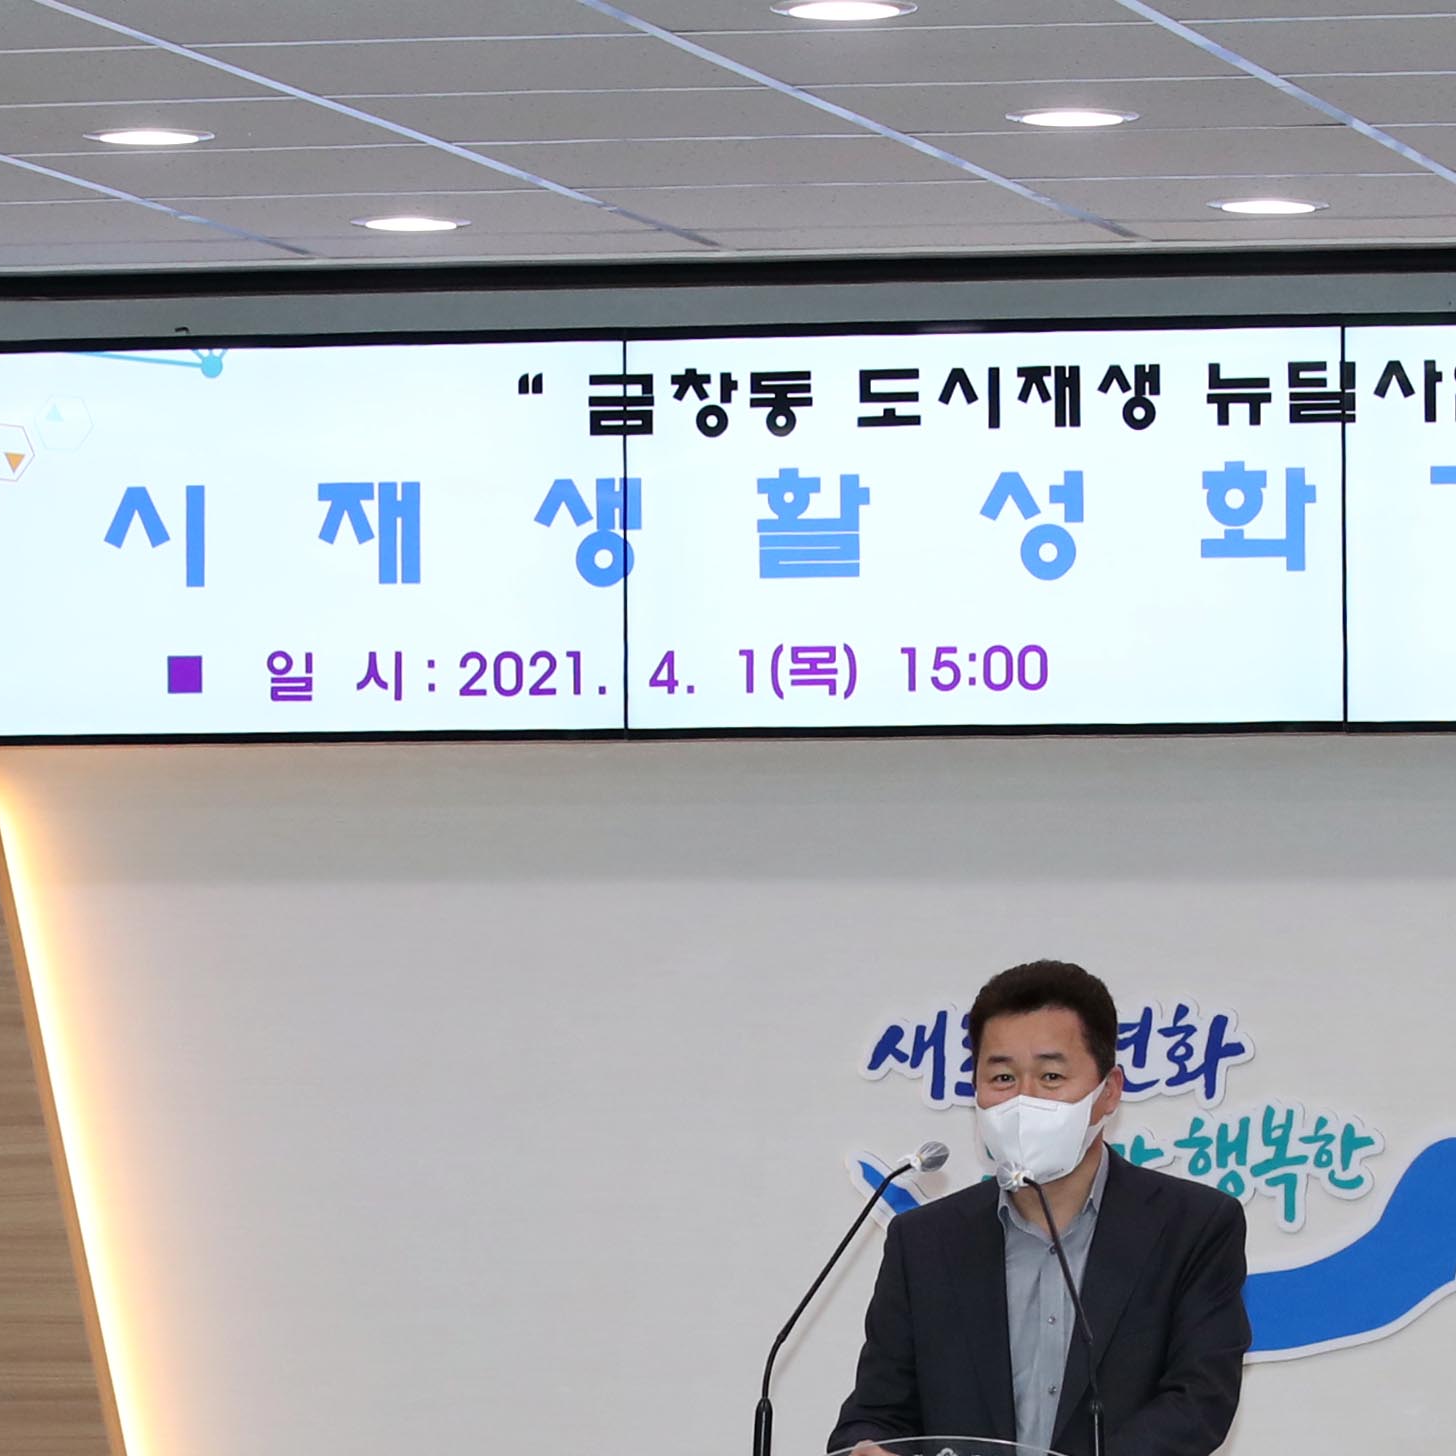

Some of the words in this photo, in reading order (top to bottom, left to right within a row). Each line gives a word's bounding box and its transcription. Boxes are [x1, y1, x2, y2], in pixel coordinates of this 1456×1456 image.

[588, 368, 813, 438] 금창동
[857, 364, 1160, 430] 도시재생
[739, 643, 856, 699] 1(목)
[901, 645, 1048, 691] 15:00
[1174, 1104, 1376, 1222] 행복한
